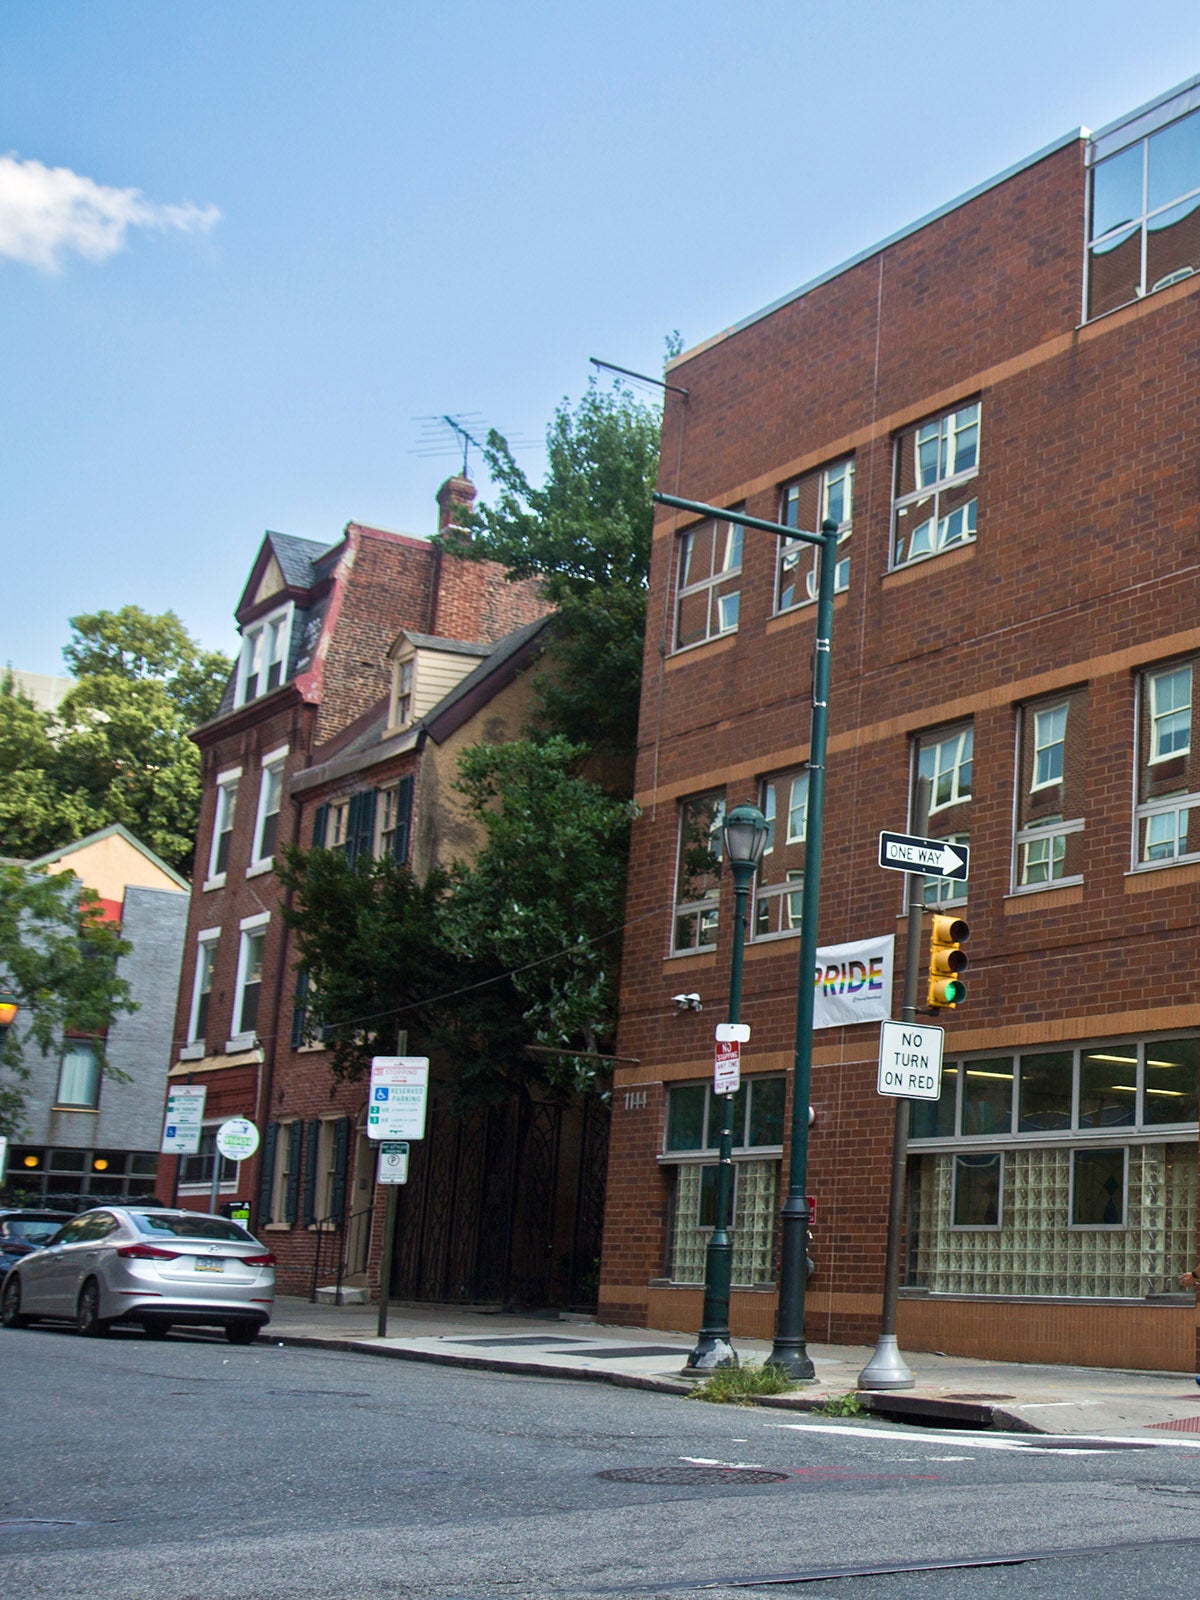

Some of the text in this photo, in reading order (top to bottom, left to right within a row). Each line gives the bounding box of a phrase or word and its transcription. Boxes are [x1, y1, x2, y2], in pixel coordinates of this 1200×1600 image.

[891, 845, 942, 865] ONE WAY
[722, 1043, 732, 1053] NO
[902, 1033, 923, 1048] NO
[717, 1051, 738, 1060] STOPPING
[894, 1051, 929, 1068] TURN
[885, 1071, 934, 1090] ON RED
[391, 1087, 424, 1095] RESERVED
[624, 1090, 648, 1110] 1144
